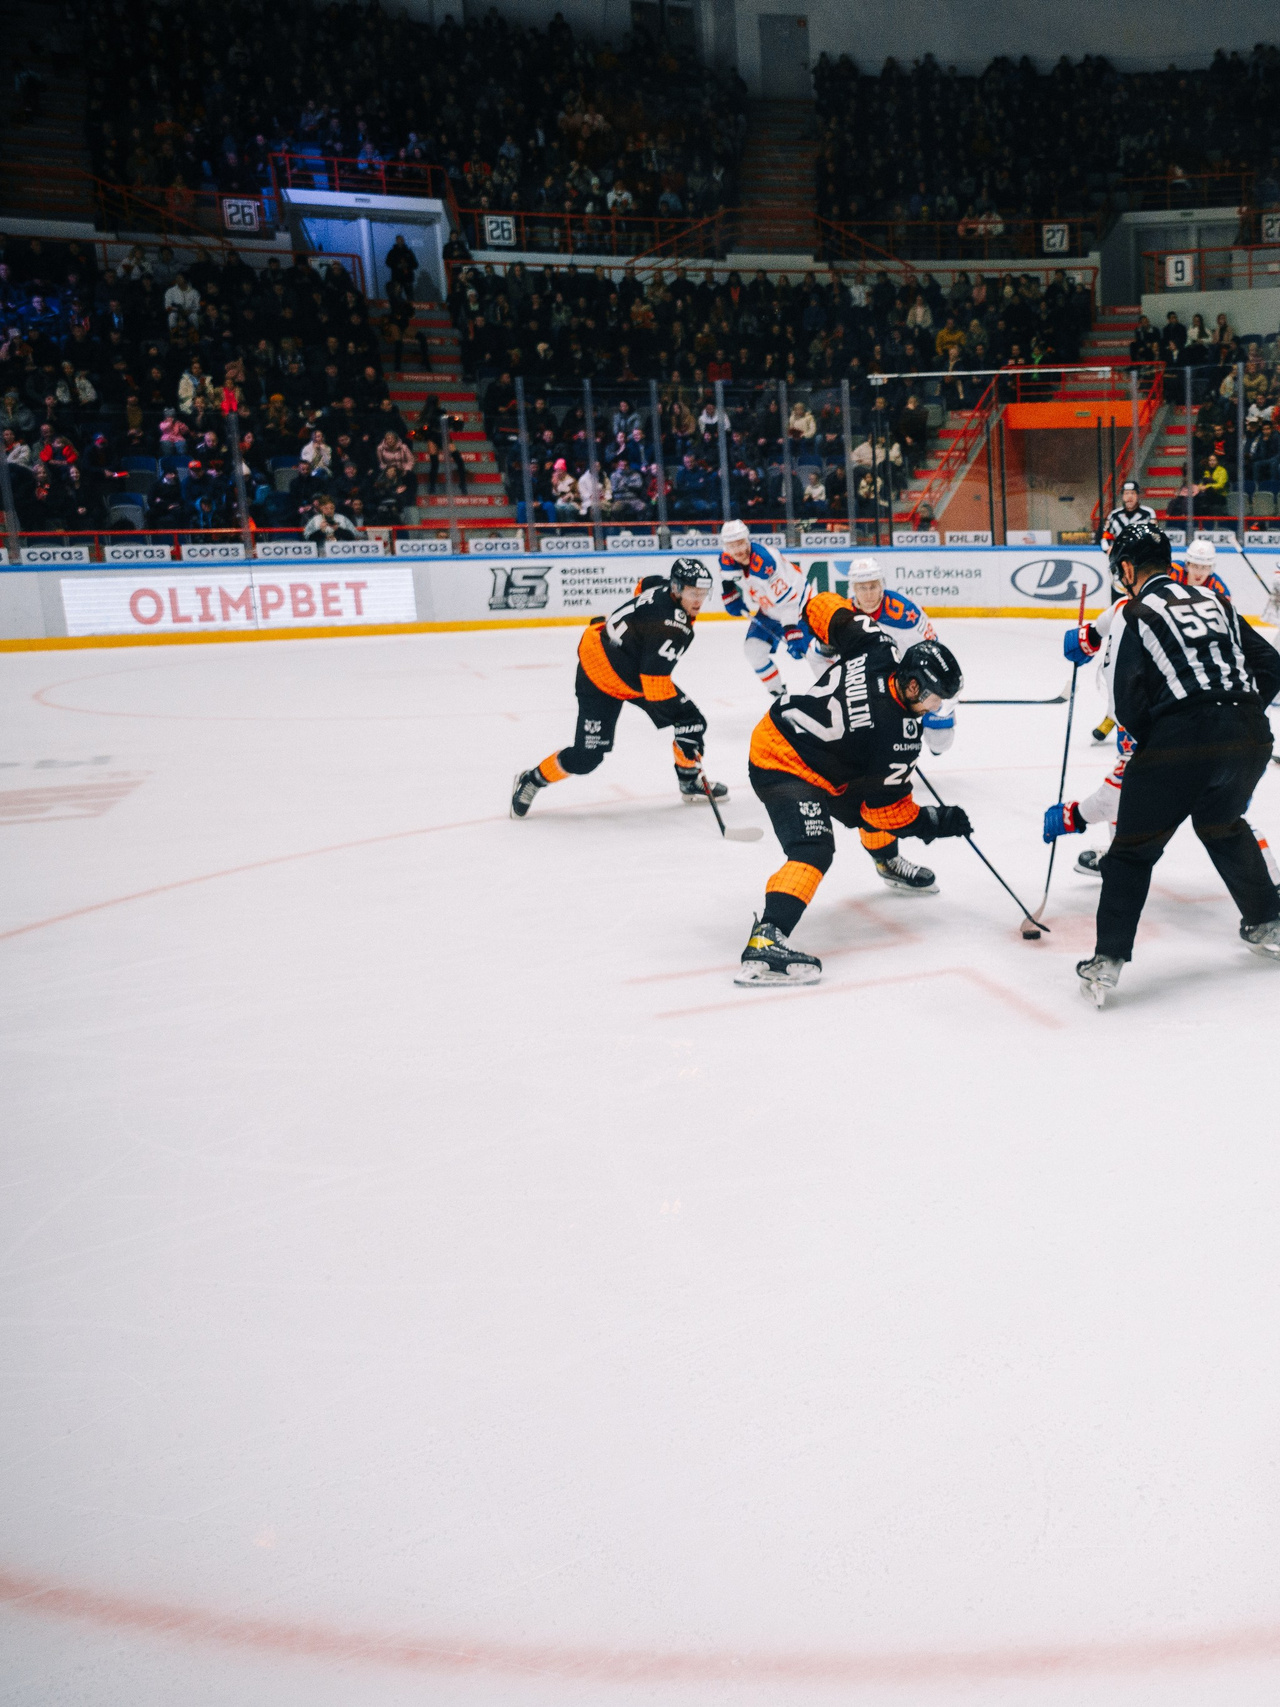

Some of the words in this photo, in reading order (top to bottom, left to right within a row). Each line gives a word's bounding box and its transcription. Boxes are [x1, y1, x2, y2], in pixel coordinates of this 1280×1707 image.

[227, 203, 252, 227] 26
[489, 220, 512, 241] 26
[1045, 228, 1067, 250] 27
[1174, 260, 1187, 281] 9
[949, 534, 989, 543] KHL.RU
[561, 567, 605, 575] ФОНБЕТ
[896, 566, 982, 580] Платёжная
[563, 588, 632, 597] ХОККЕЙНАЯ
[770, 578, 789, 597] 23
[129, 581, 368, 625] OLIMPBET
[562, 599, 592, 607] ЛИГА
[1170, 603, 1228, 638] 55
[845, 656, 873, 729] BARULIN
